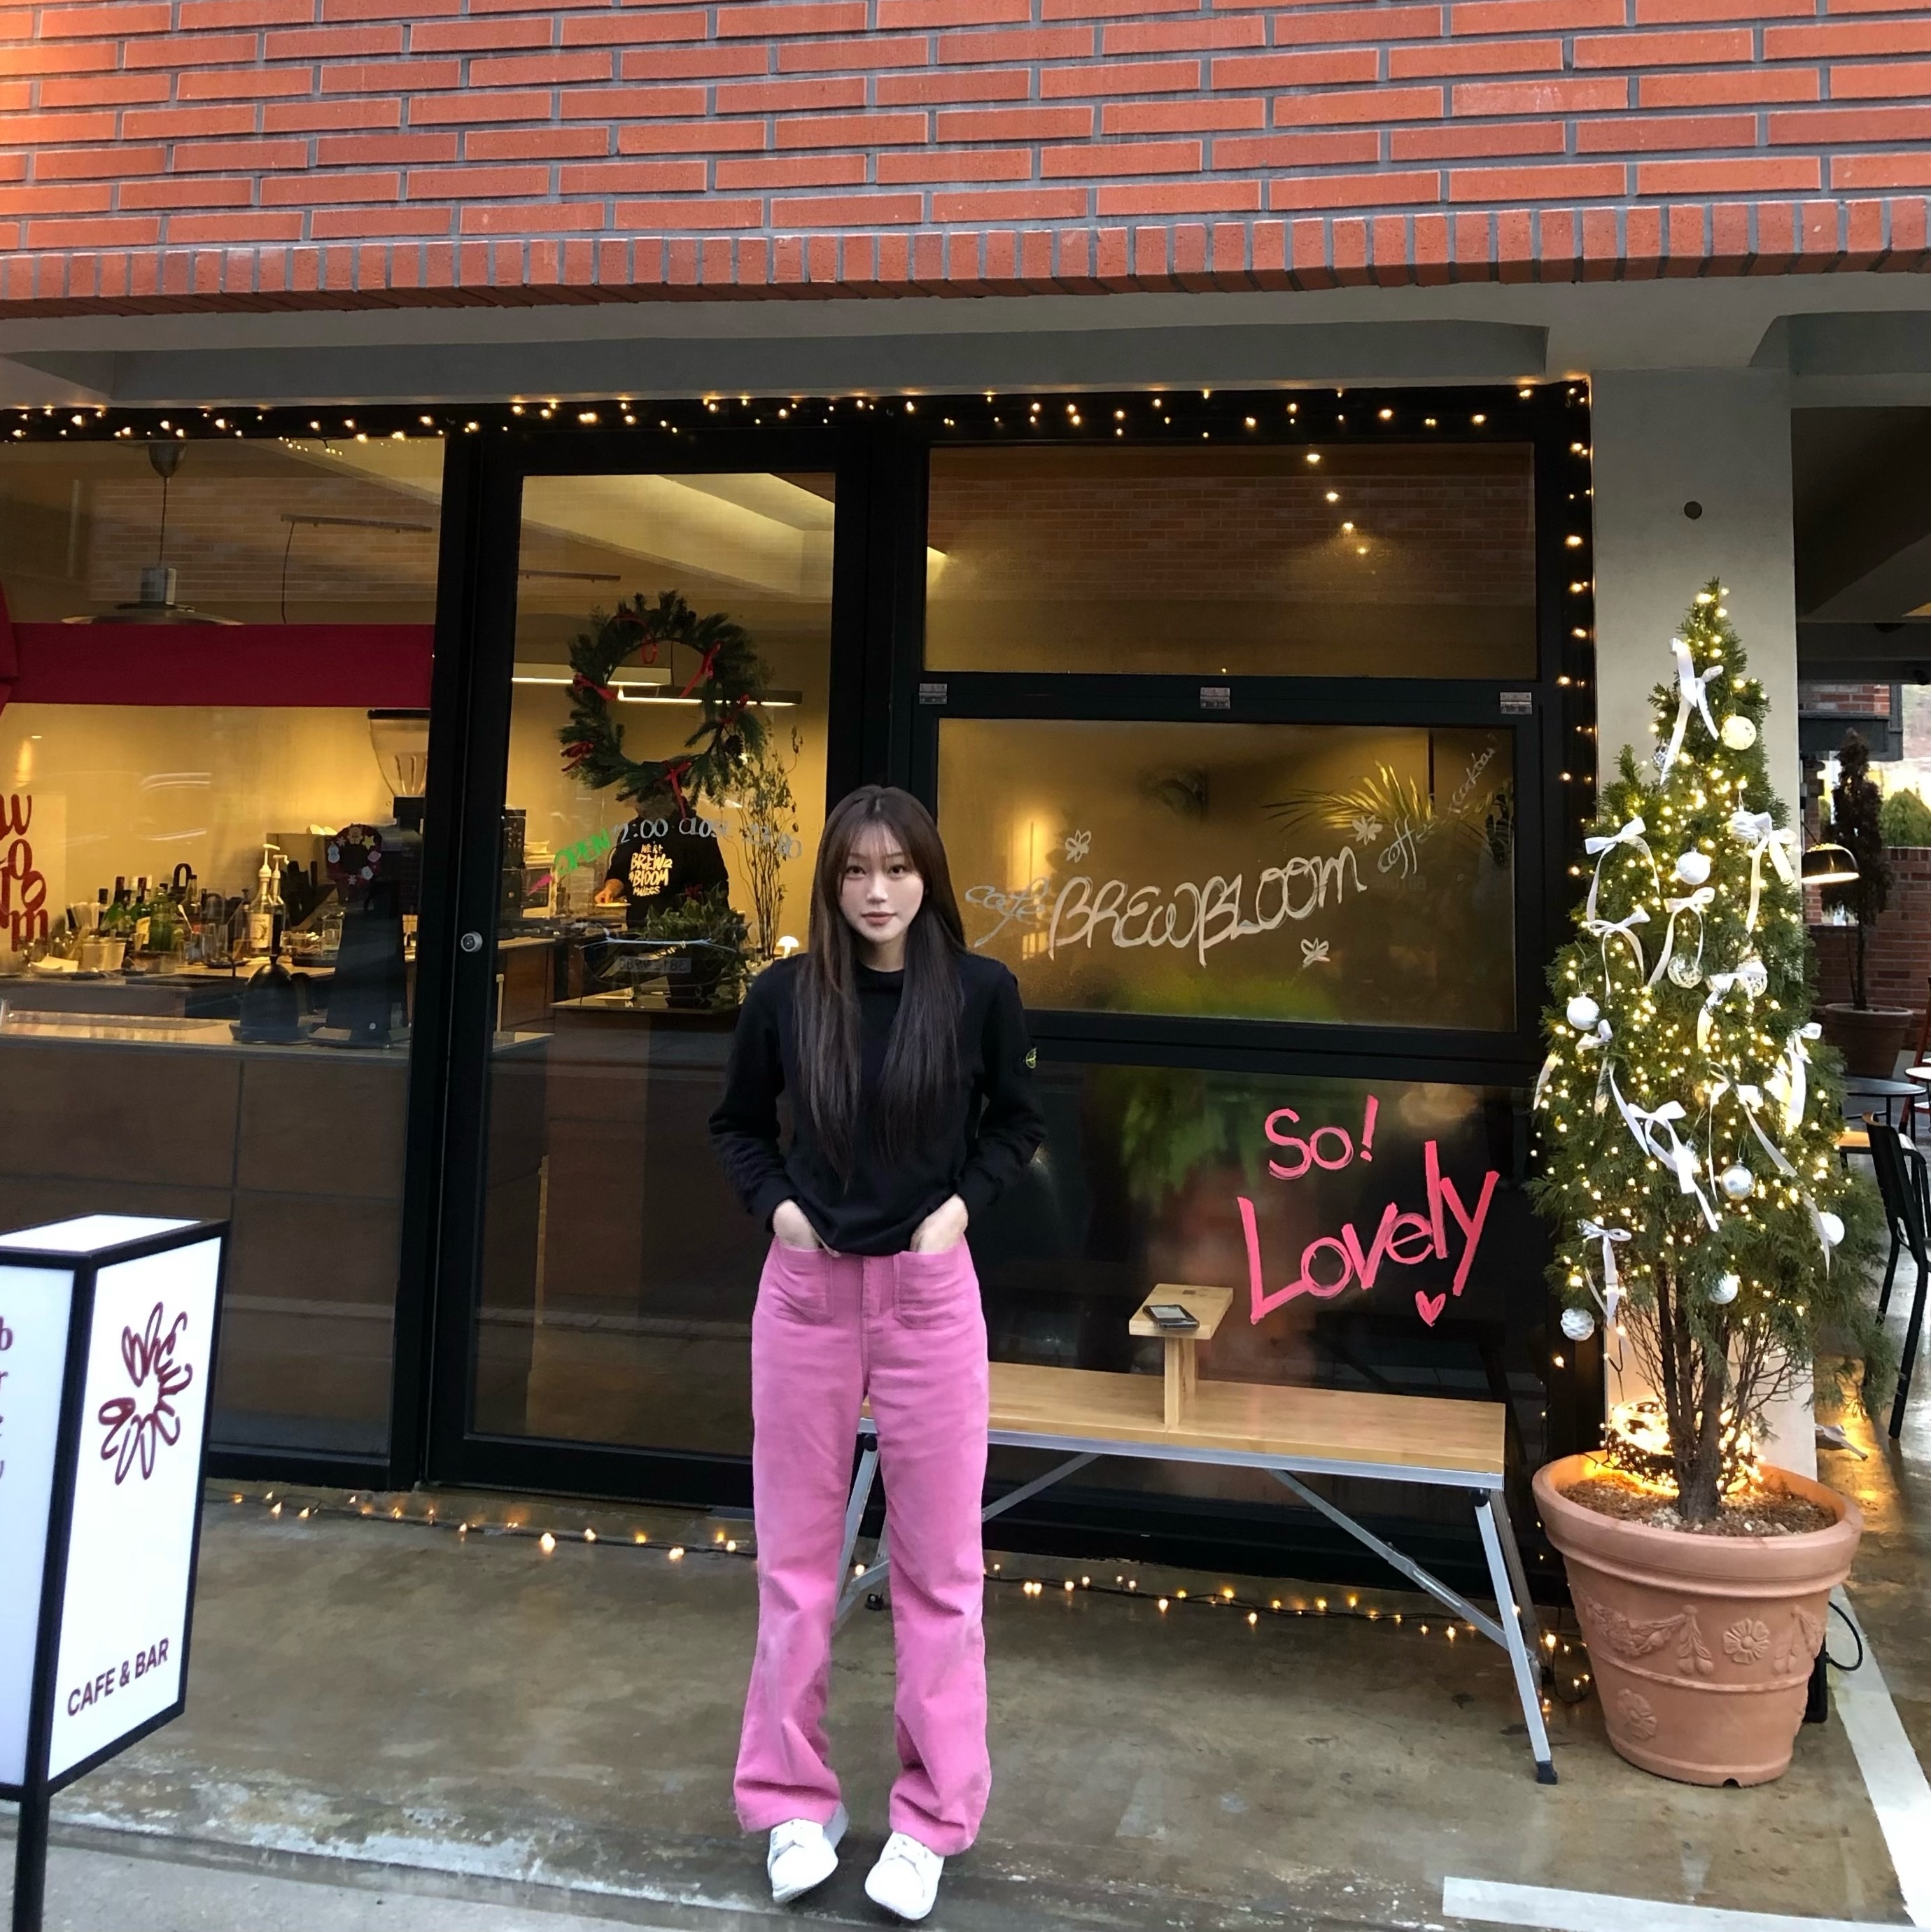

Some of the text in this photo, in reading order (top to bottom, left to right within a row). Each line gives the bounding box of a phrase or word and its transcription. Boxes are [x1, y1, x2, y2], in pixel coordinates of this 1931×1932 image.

[554, 828, 610, 876] OPEN
[1265, 1094, 1378, 1180] So!
[1237, 1140, 1500, 1325] Lovely
[67, 1637, 169, 1716] CAFE & BAR
